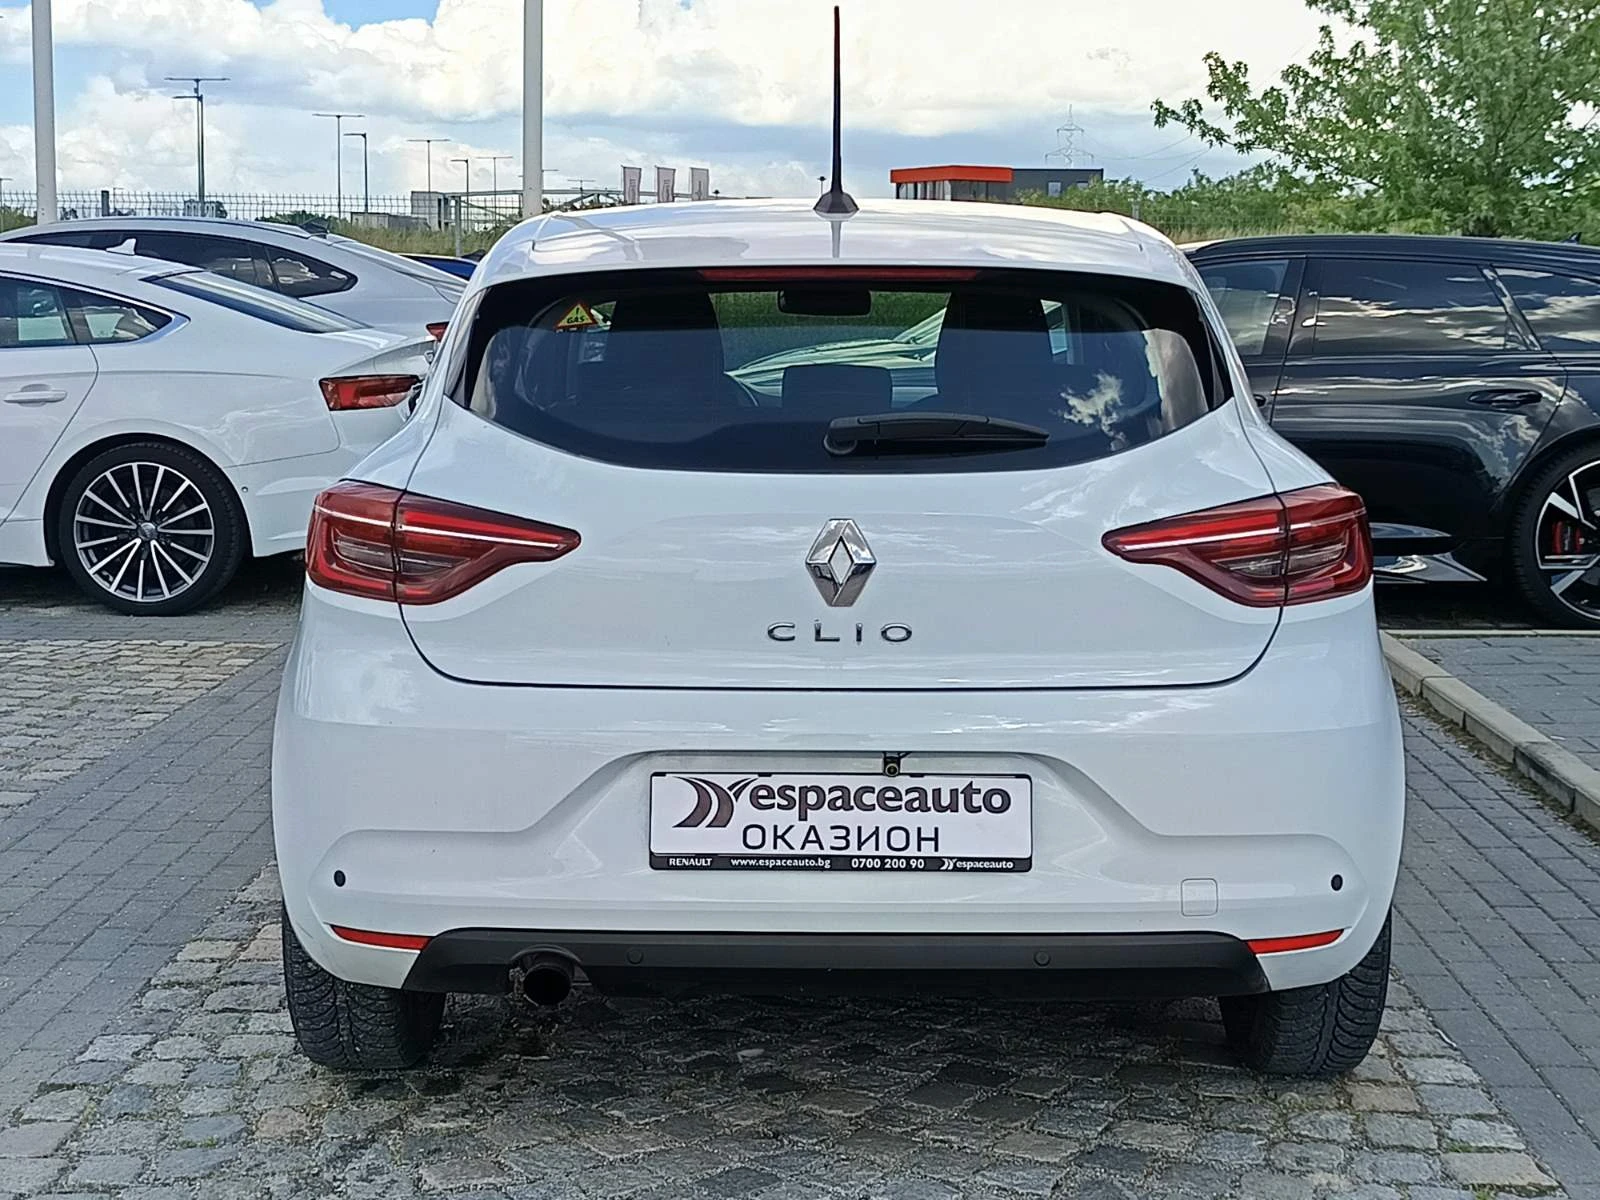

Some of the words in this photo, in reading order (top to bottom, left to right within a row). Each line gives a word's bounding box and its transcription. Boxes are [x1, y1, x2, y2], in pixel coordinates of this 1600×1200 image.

[567, 315, 585, 324] GAS
[767, 622, 912, 642] CLIO
[749, 780, 1011, 821] espaceauto
[742, 824, 939, 852] ОКАЗИОН
[669, 858, 713, 866] RENAULT
[730, 858, 831, 868] www.espaceauto.bg
[851, 858, 881, 868] 0700
[884, 858, 907, 868] 200
[909, 858, 925, 869] 90
[955, 860, 1014, 870] espaceauto
